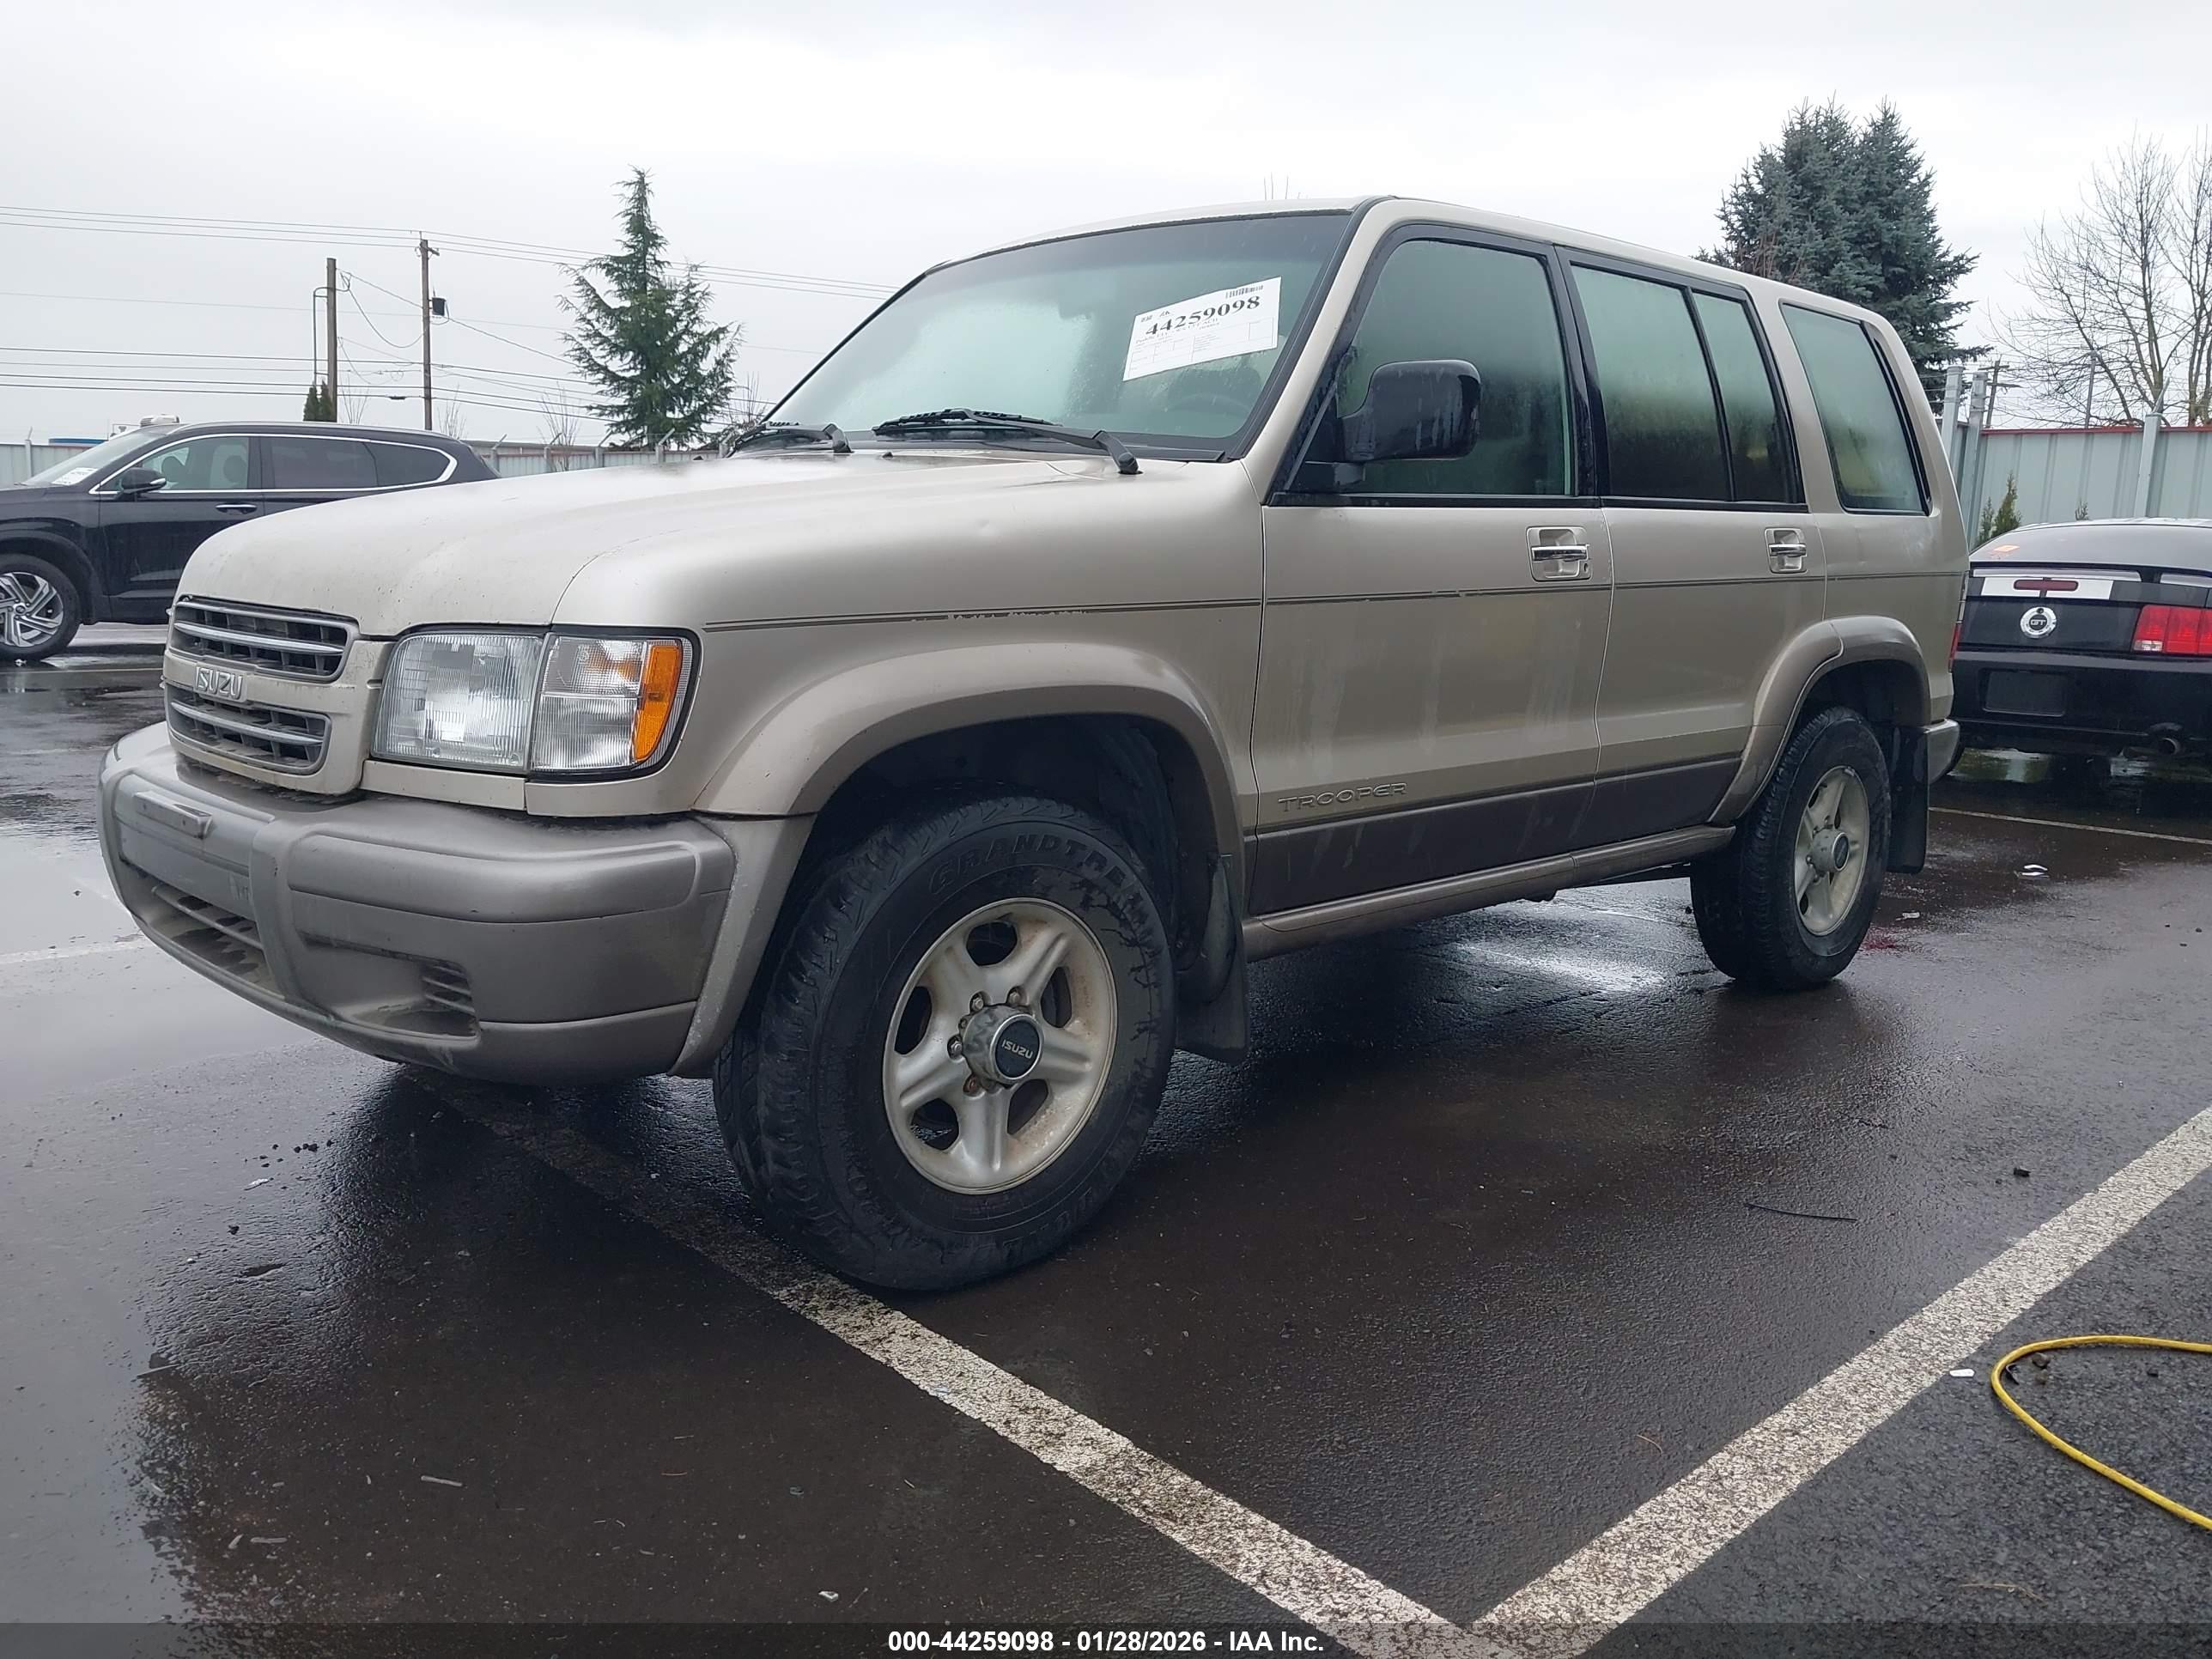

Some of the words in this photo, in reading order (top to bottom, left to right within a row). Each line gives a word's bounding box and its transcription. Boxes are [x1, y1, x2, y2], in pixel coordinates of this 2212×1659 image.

[1146, 295, 1261, 335] 44259098
[196, 665, 243, 700] ISUZU
[1278, 782, 1408, 811] TROOPER
[1001, 1039, 1034, 1060] ISUZU
